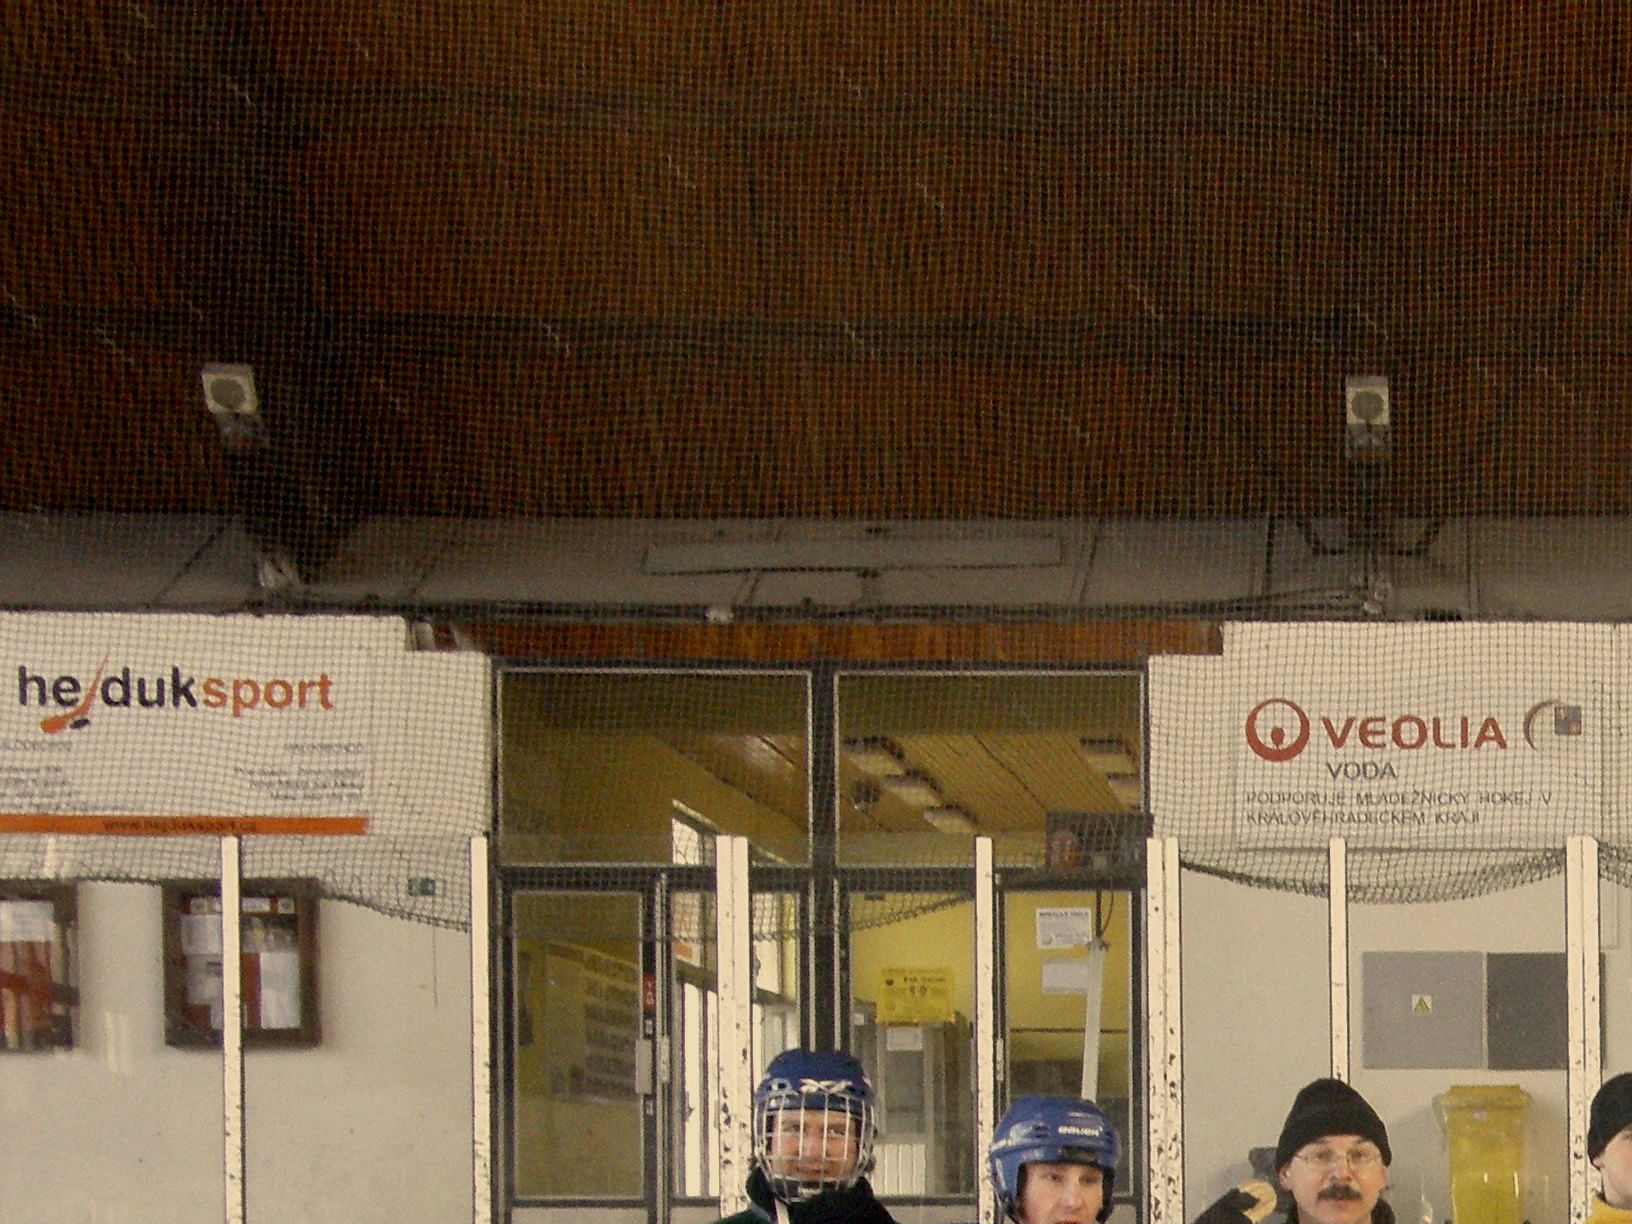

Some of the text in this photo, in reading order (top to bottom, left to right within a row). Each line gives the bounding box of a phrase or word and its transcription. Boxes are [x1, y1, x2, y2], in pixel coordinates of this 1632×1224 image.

[1322, 715, 1507, 750] VEOLIA
[1327, 762, 1397, 781] VODA
[1247, 791, 1345, 806] PODPORUJE
